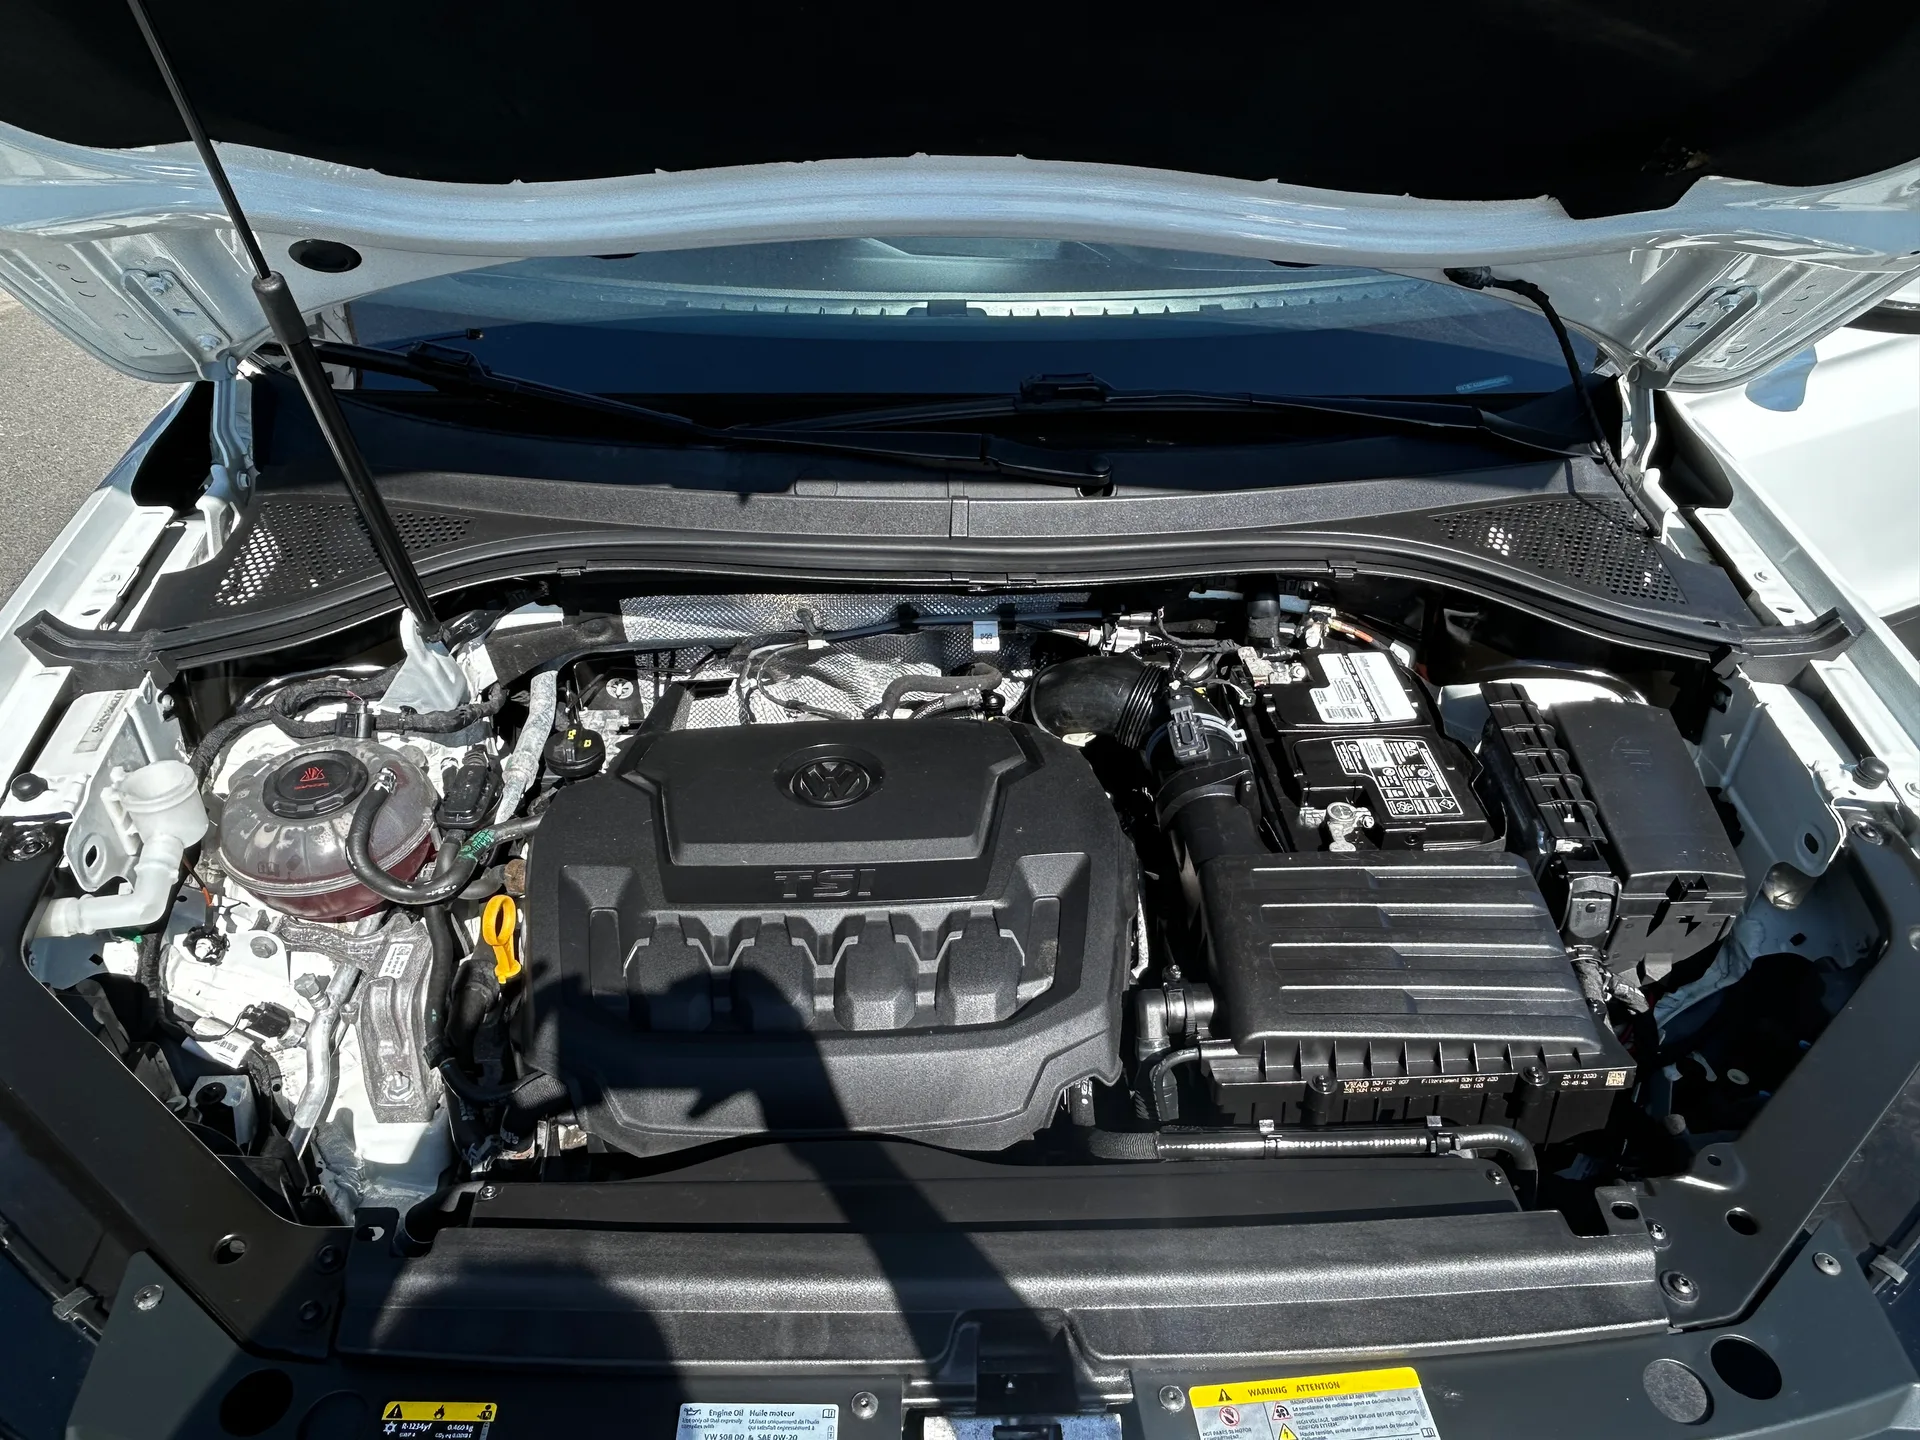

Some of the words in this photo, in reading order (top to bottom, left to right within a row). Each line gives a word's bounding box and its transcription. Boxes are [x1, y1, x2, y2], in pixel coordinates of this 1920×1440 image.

[773, 868, 876, 899] TSI
[1247, 1386, 1288, 1397] WARNING
[1296, 1381, 1341, 1393] ATTENTION
[708, 1409, 733, 1418] Engine
[733, 1409, 744, 1417] Oil
[749, 1409, 768, 1417] Huile
